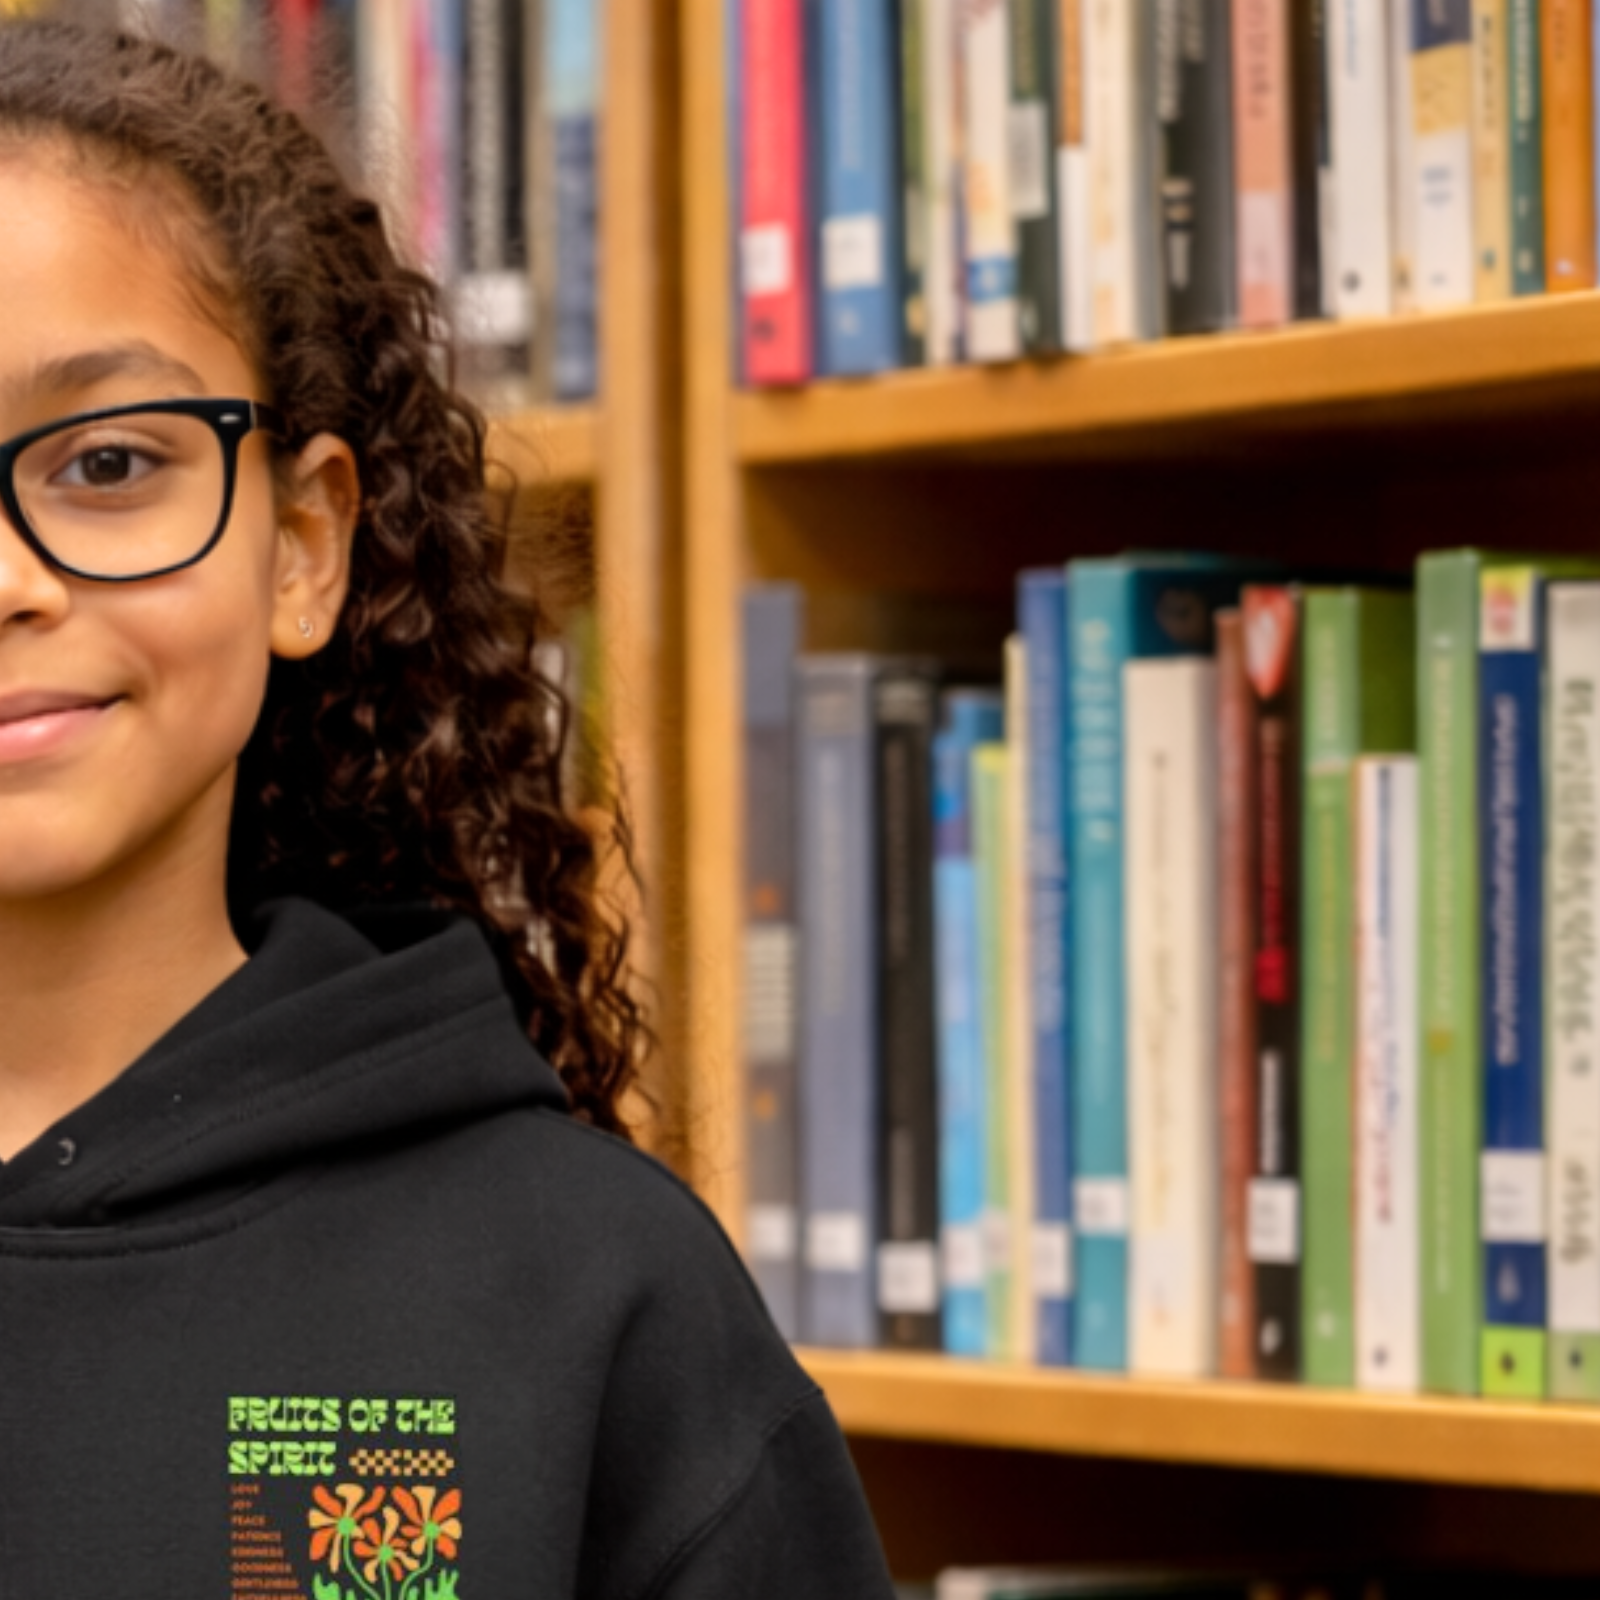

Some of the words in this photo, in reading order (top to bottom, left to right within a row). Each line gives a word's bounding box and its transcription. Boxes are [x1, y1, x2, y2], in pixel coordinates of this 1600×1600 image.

[228, 1397, 341, 1432] FRUITS
[349, 1399, 388, 1433] OF
[395, 1399, 455, 1434] THE
[228, 1441, 337, 1475] SPIRIT
[230, 1516, 266, 1526] PEACE
